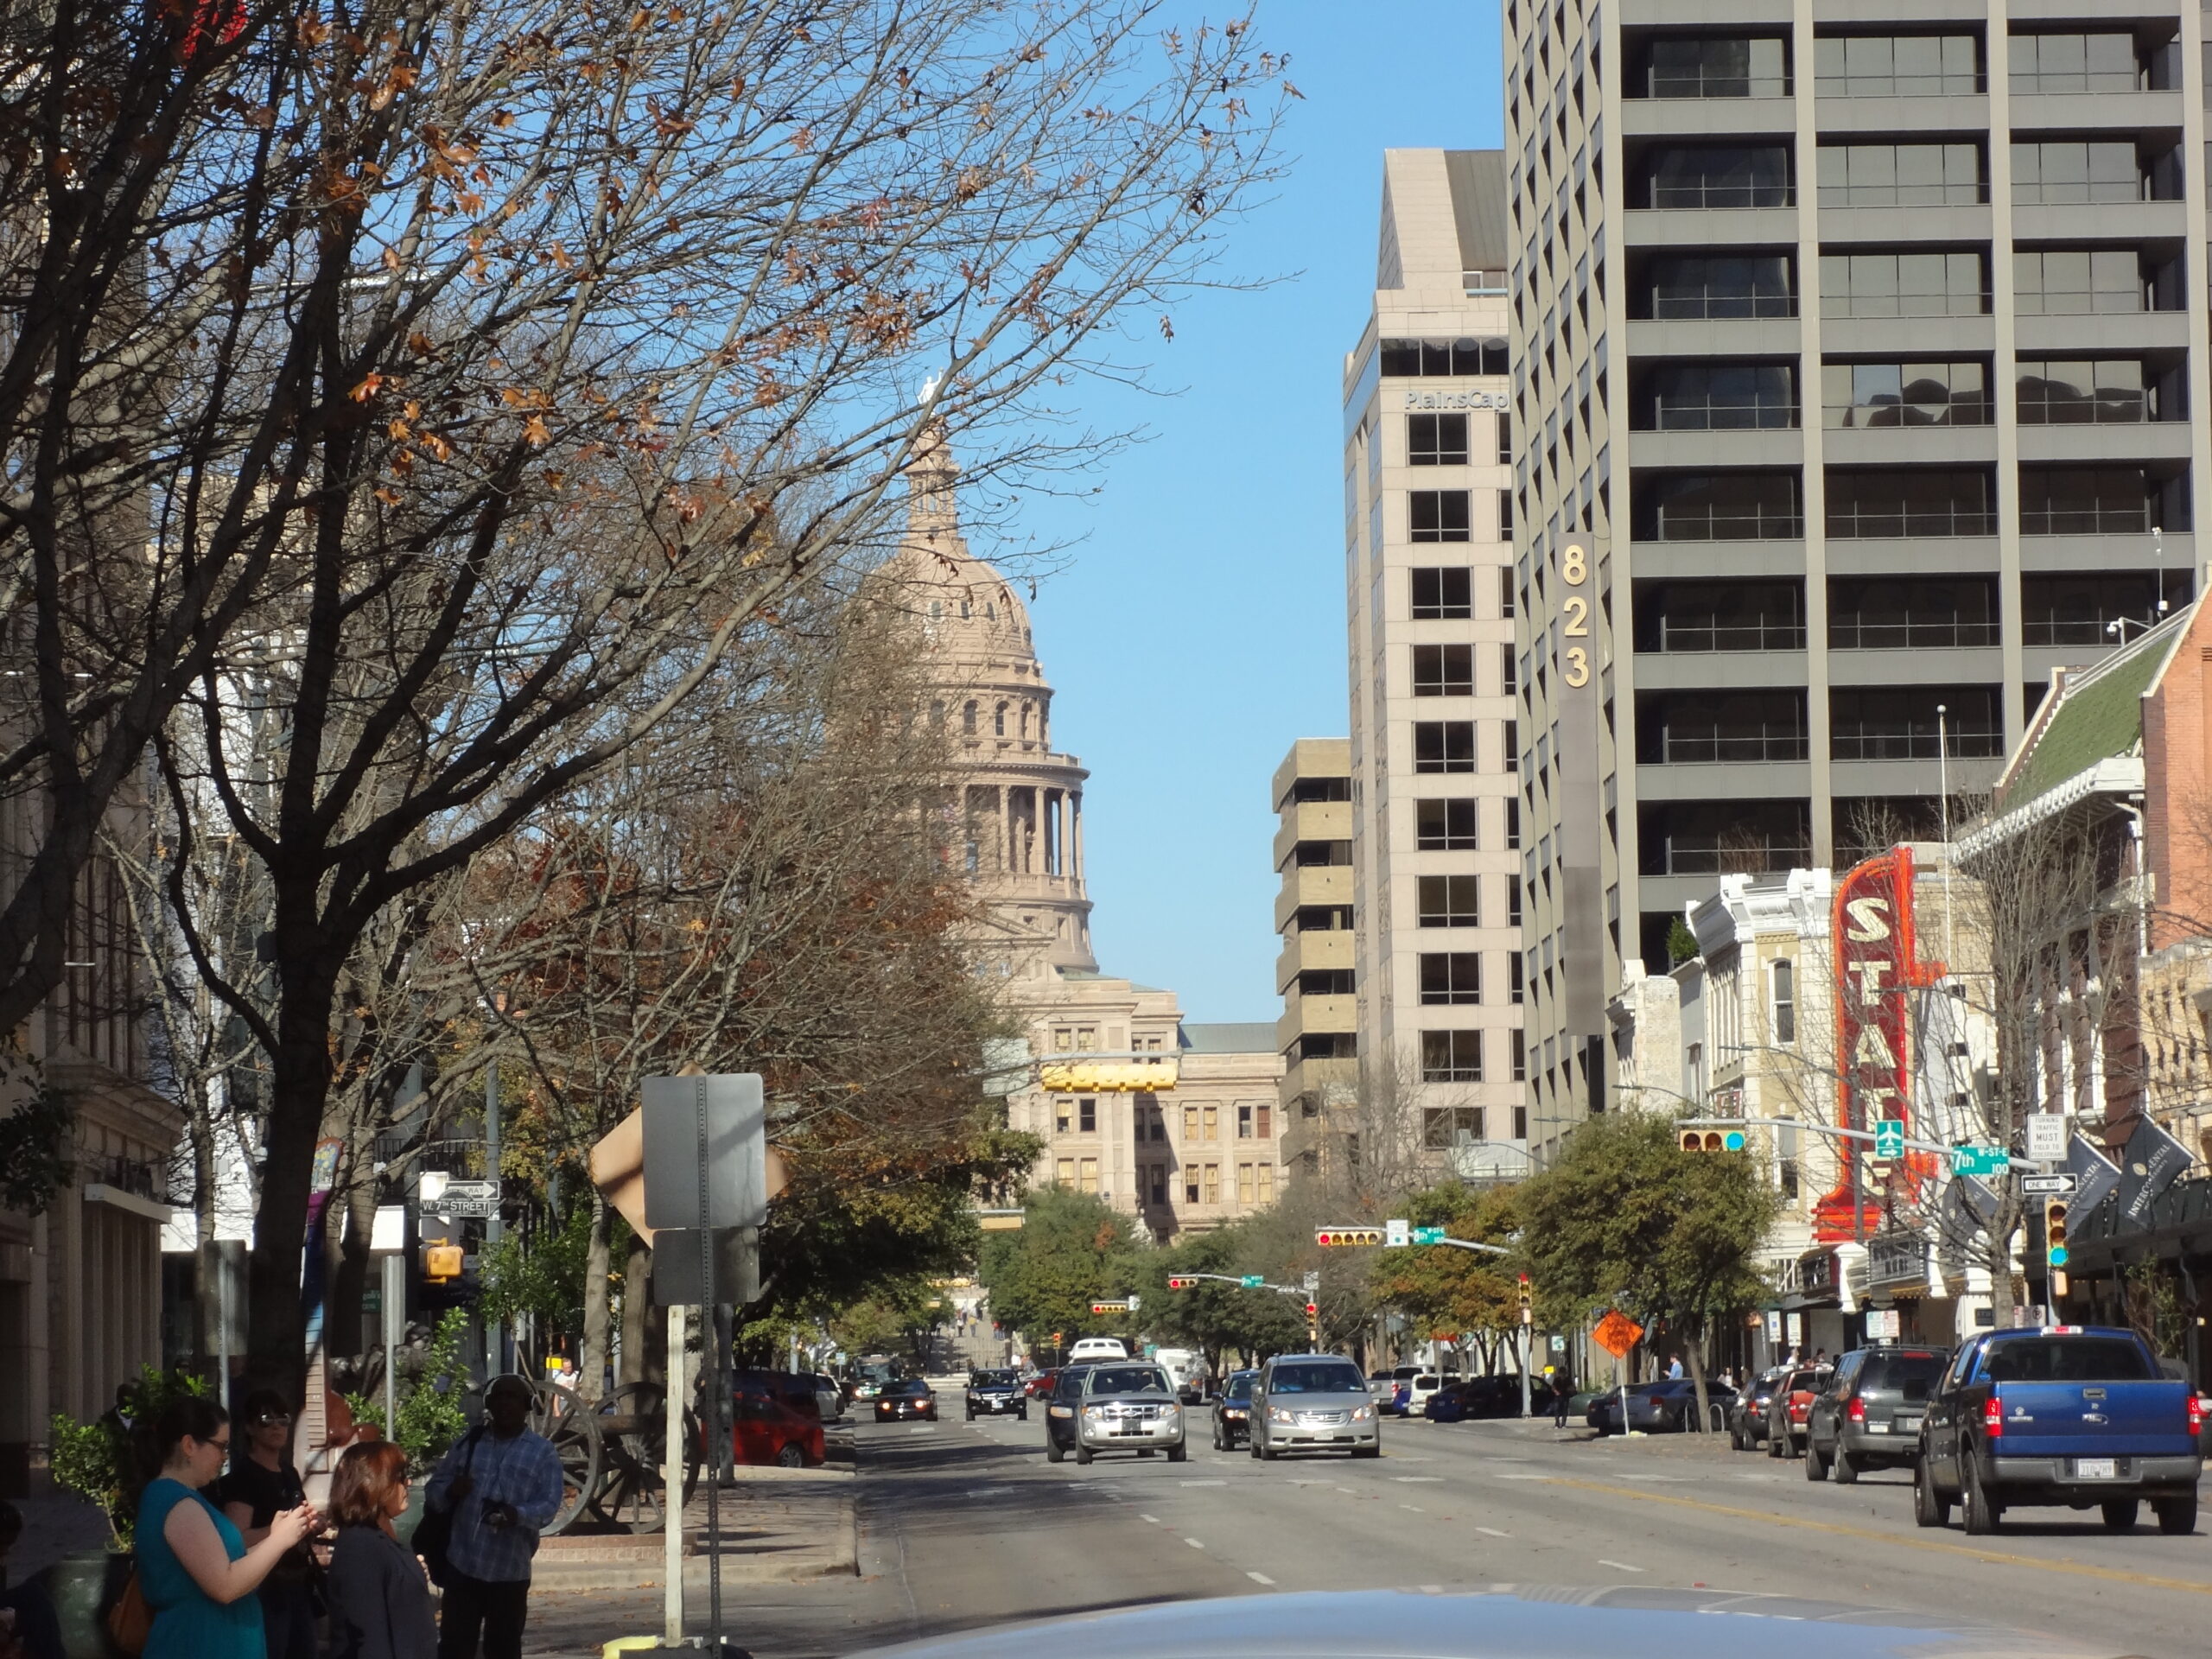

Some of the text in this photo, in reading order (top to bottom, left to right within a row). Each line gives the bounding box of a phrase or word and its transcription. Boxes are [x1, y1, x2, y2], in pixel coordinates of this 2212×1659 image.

[1405, 389, 1509, 412] PlainsCap
[1563, 545, 1589, 688] 823
[1847, 897, 1897, 1197] STATE
[2036, 1133, 2058, 1141] MUST
[1953, 1150, 1974, 1171] 7th
[1992, 1163, 2009, 1174] 100
[2028, 1180, 2042, 1189] ONE
[423, 1201, 434, 1211] W.
[449, 1201, 487, 1211] STREET
[1414, 1230, 1428, 1243] 8th
